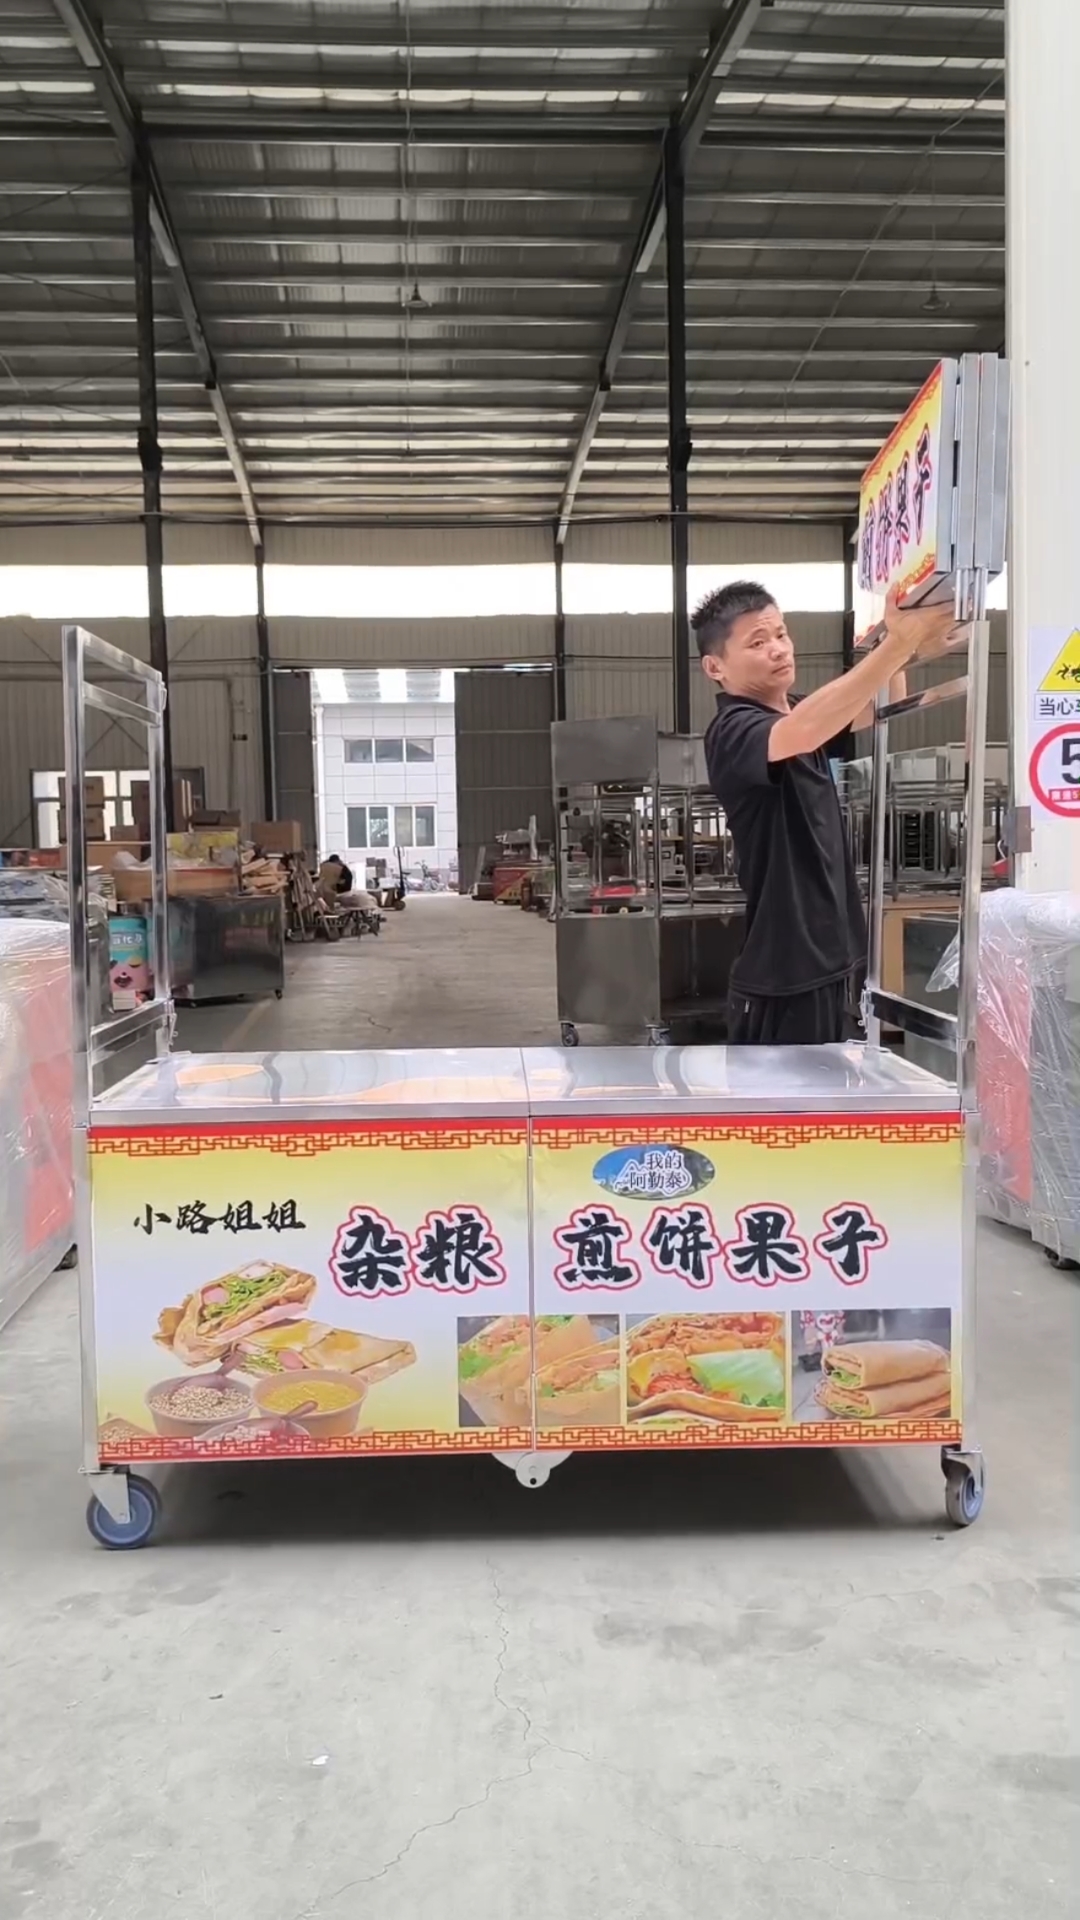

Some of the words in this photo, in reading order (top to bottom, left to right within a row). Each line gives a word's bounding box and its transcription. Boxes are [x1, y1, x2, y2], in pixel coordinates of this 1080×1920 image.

[645, 1151, 683, 1171] 我的
[629, 1170, 683, 1190] 阿勒泰
[133, 1199, 307, 1236] 小路姐姐
[334, 1210, 501, 1294] 杂粮
[558, 1207, 884, 1286] 煎饼果子
